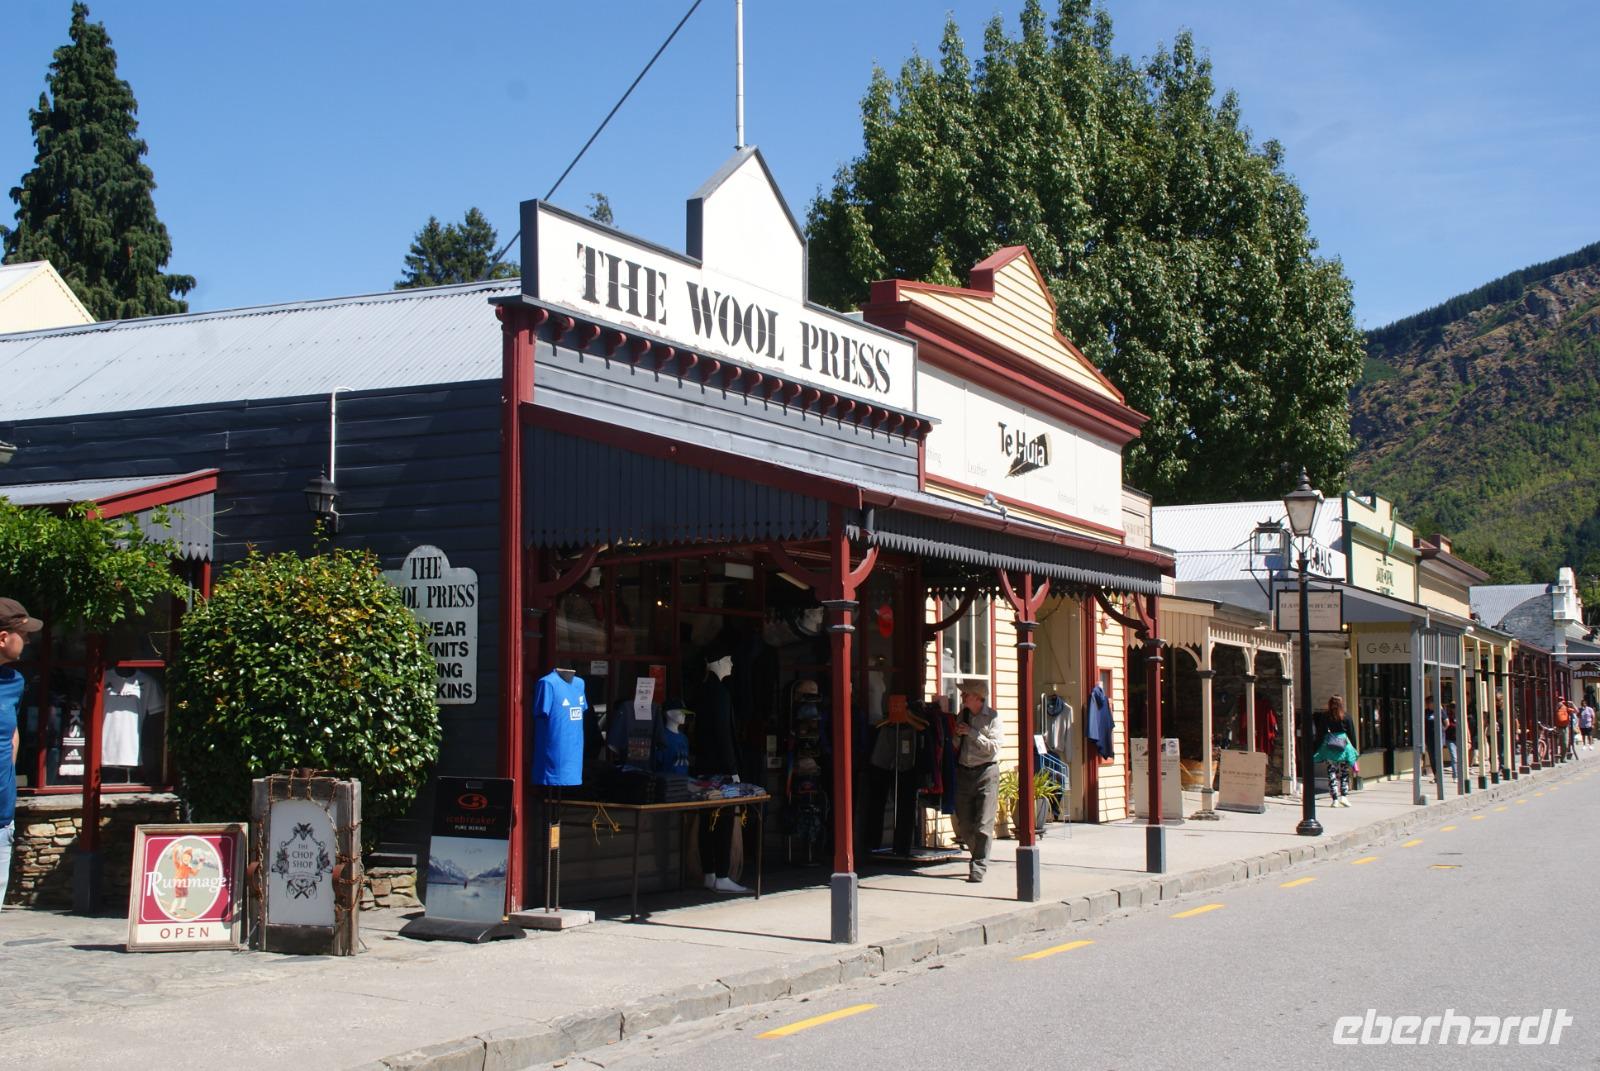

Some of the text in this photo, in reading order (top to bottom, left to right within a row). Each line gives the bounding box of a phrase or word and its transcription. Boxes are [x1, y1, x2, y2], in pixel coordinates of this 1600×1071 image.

[577, 241, 891, 395] THE WOOL PRESS
[997, 421, 1045, 467] Te Huia
[410, 556, 442, 580] THE
[427, 583, 475, 608] PRESS
[291, 851, 314, 859] CHOP
[292, 860, 314, 869] SHOP
[145, 871, 227, 897] Rummage
[160, 927, 209, 939] OPEN
